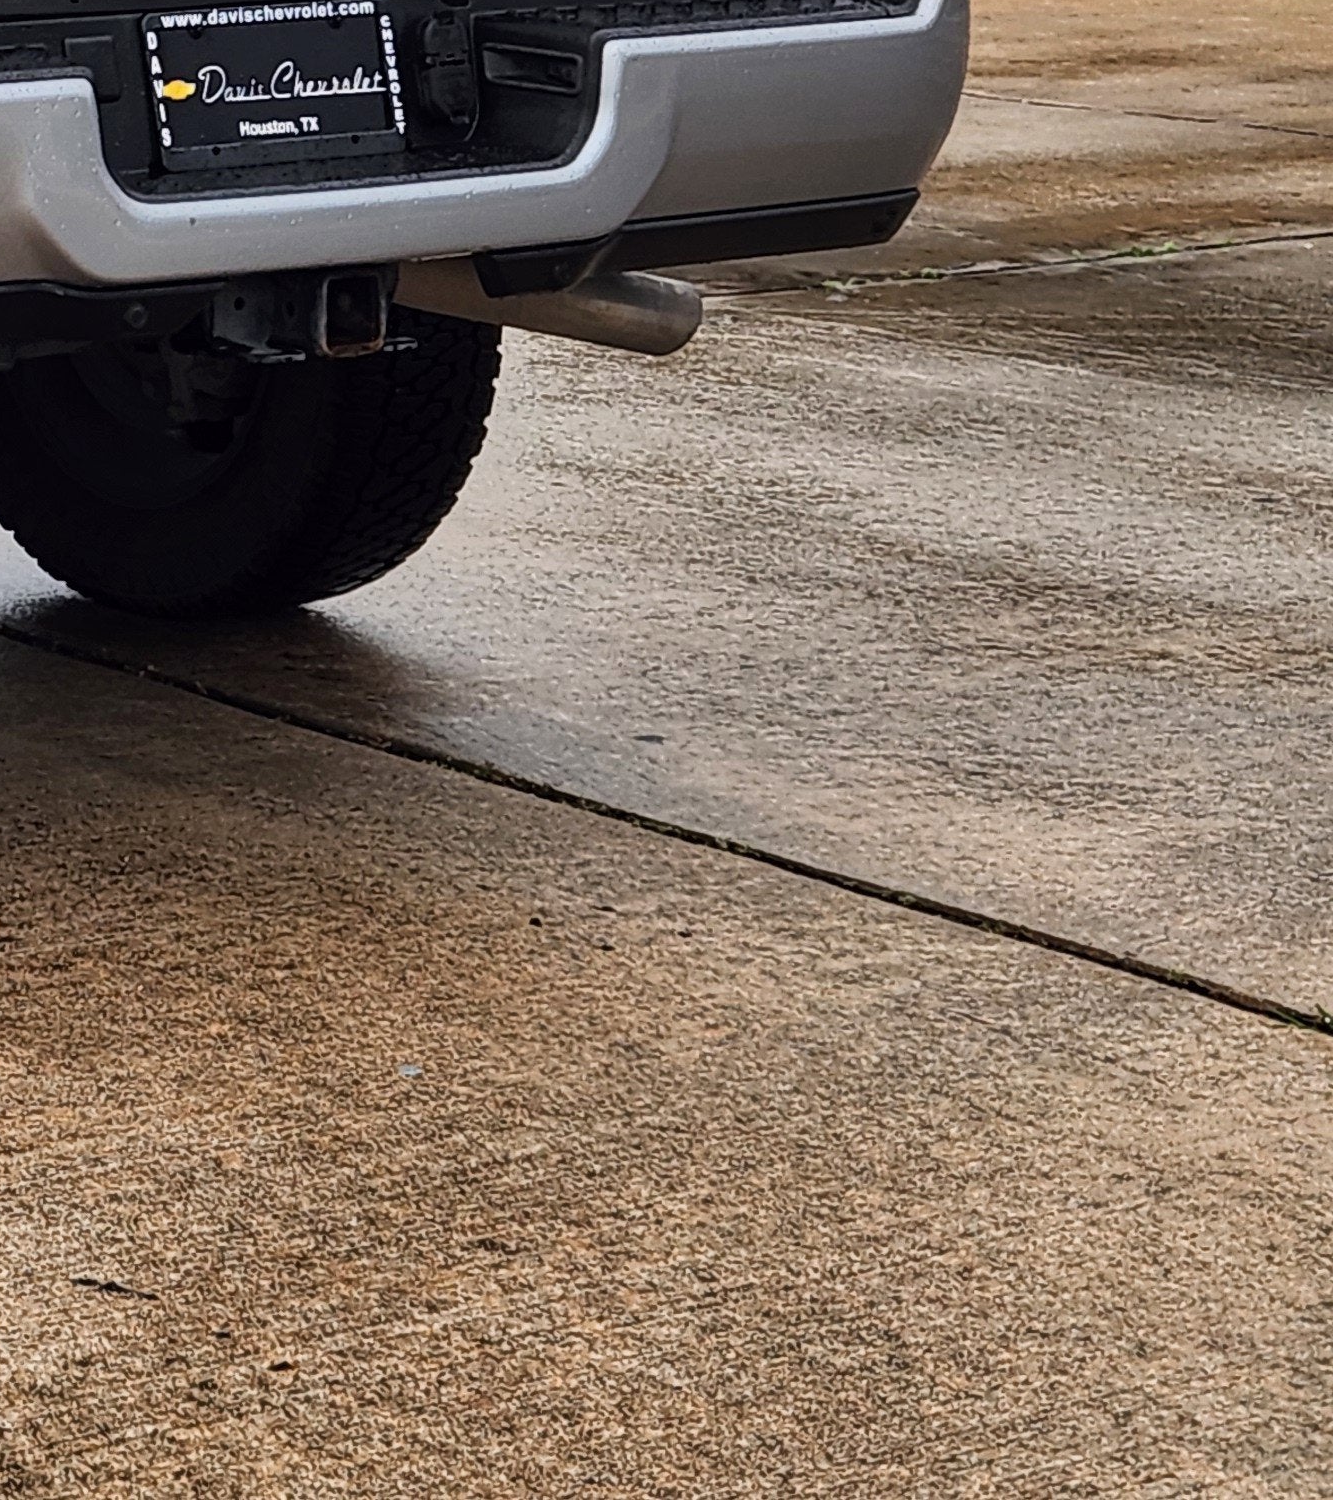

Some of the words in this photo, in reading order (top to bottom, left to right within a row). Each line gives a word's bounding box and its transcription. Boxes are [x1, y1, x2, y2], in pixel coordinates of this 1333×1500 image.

[160, 1, 375, 29] www.davischevrolet.com
[146, 31, 172, 148] DAVIS
[198, 65, 271, 104] Davis
[270, 61, 387, 99] Chevrolet
[380, 15, 407, 135] CHEVROLET
[239, 119, 299, 137] Houston,
[299, 116, 320, 133] TX
